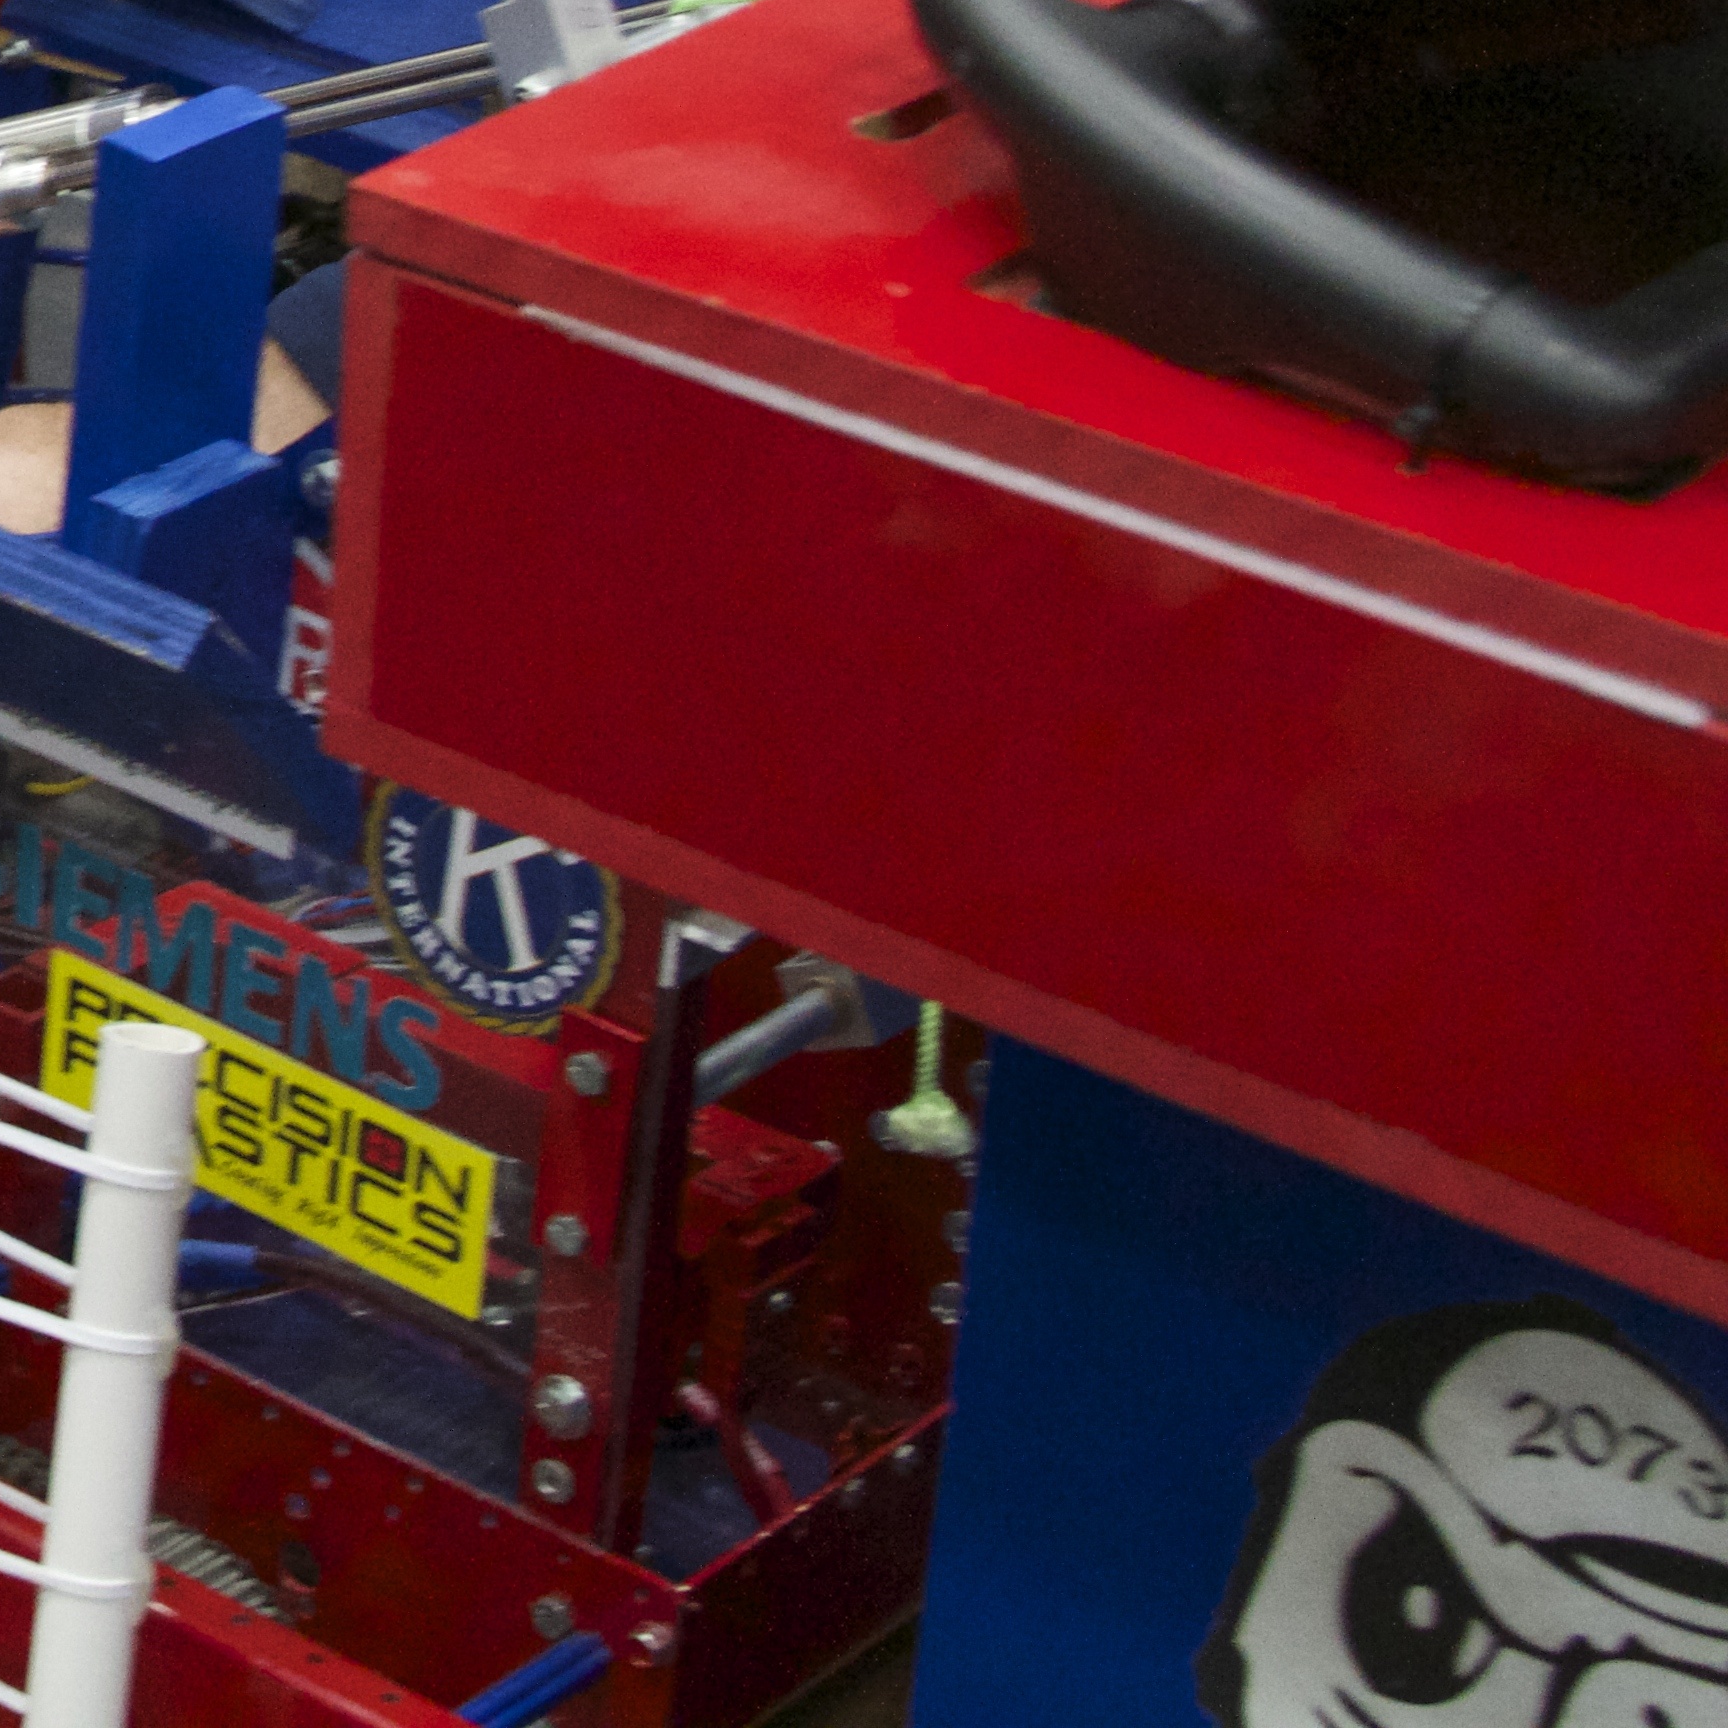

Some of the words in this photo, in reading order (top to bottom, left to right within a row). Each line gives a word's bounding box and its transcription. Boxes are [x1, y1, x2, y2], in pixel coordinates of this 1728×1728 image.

[385, 815, 600, 1008] INTERNATIONAL
[61, 1028, 462, 1264] PSTICS
[64, 977, 470, 1214] PCISION
[1504, 1390, 1728, 1520] 2073
